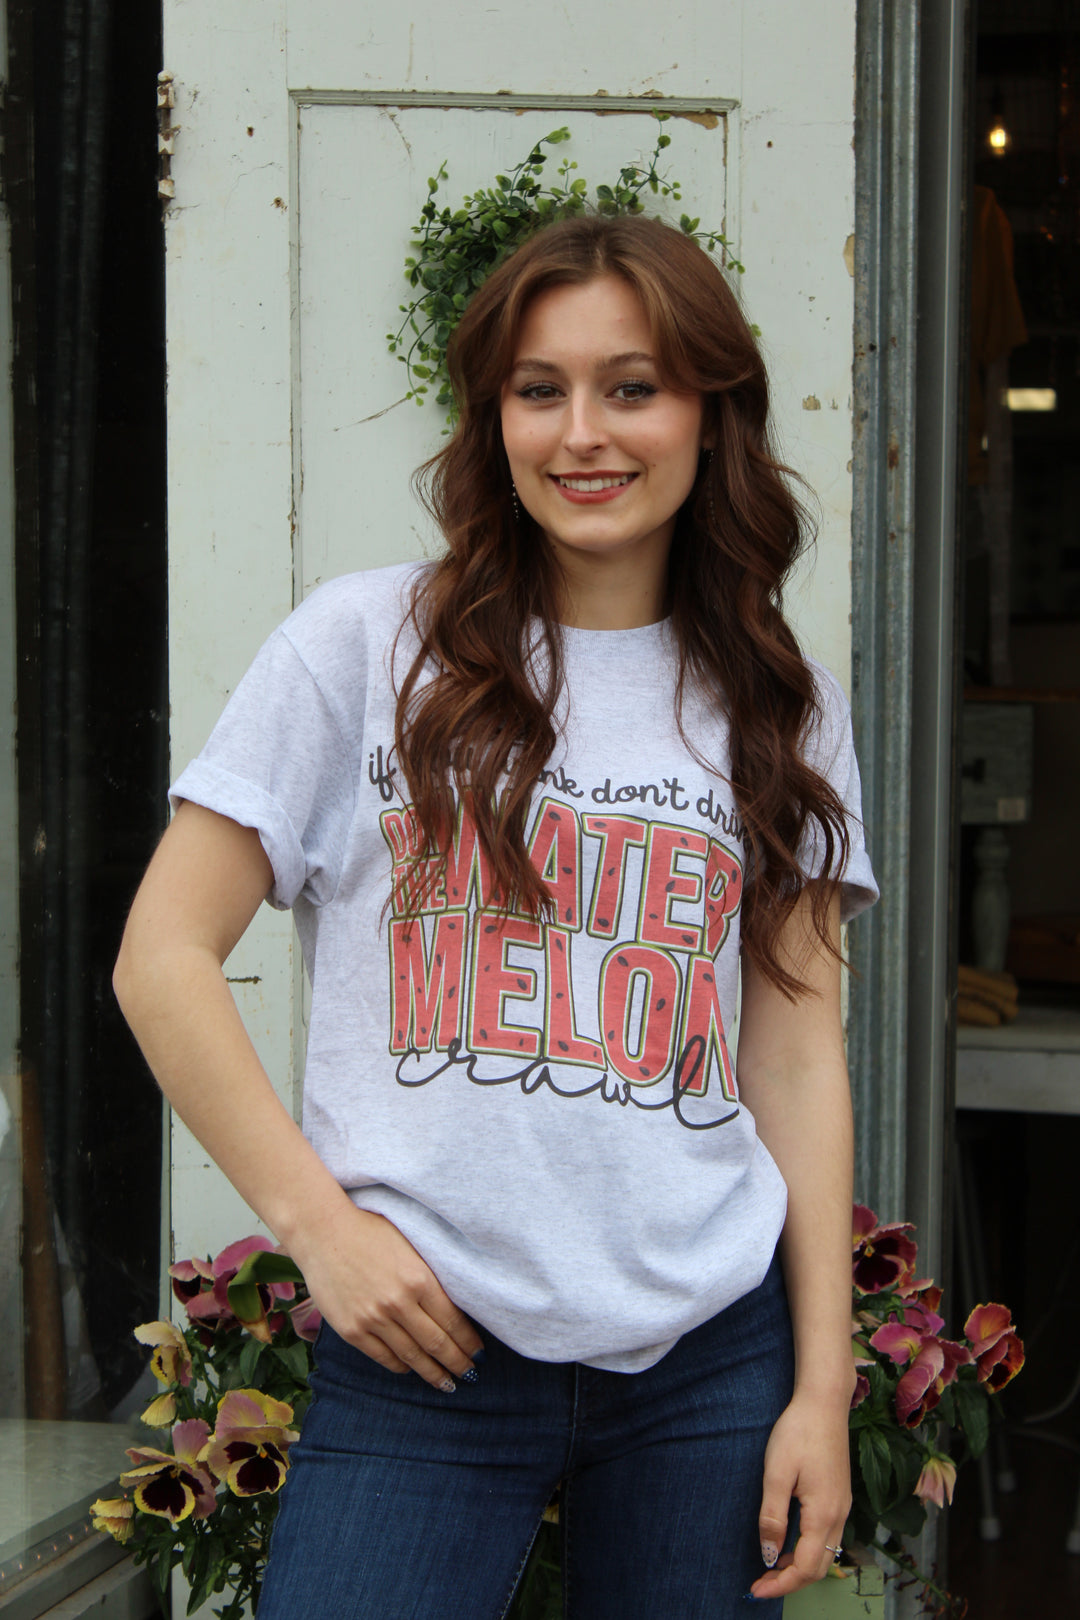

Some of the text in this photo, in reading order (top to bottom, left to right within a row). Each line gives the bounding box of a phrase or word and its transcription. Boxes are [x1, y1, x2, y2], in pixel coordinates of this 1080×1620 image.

[368, 745, 397, 802] if
[591, 777, 690, 811] don't
[391, 856, 449, 917] THE
[396, 1035, 740, 1130] crawl
